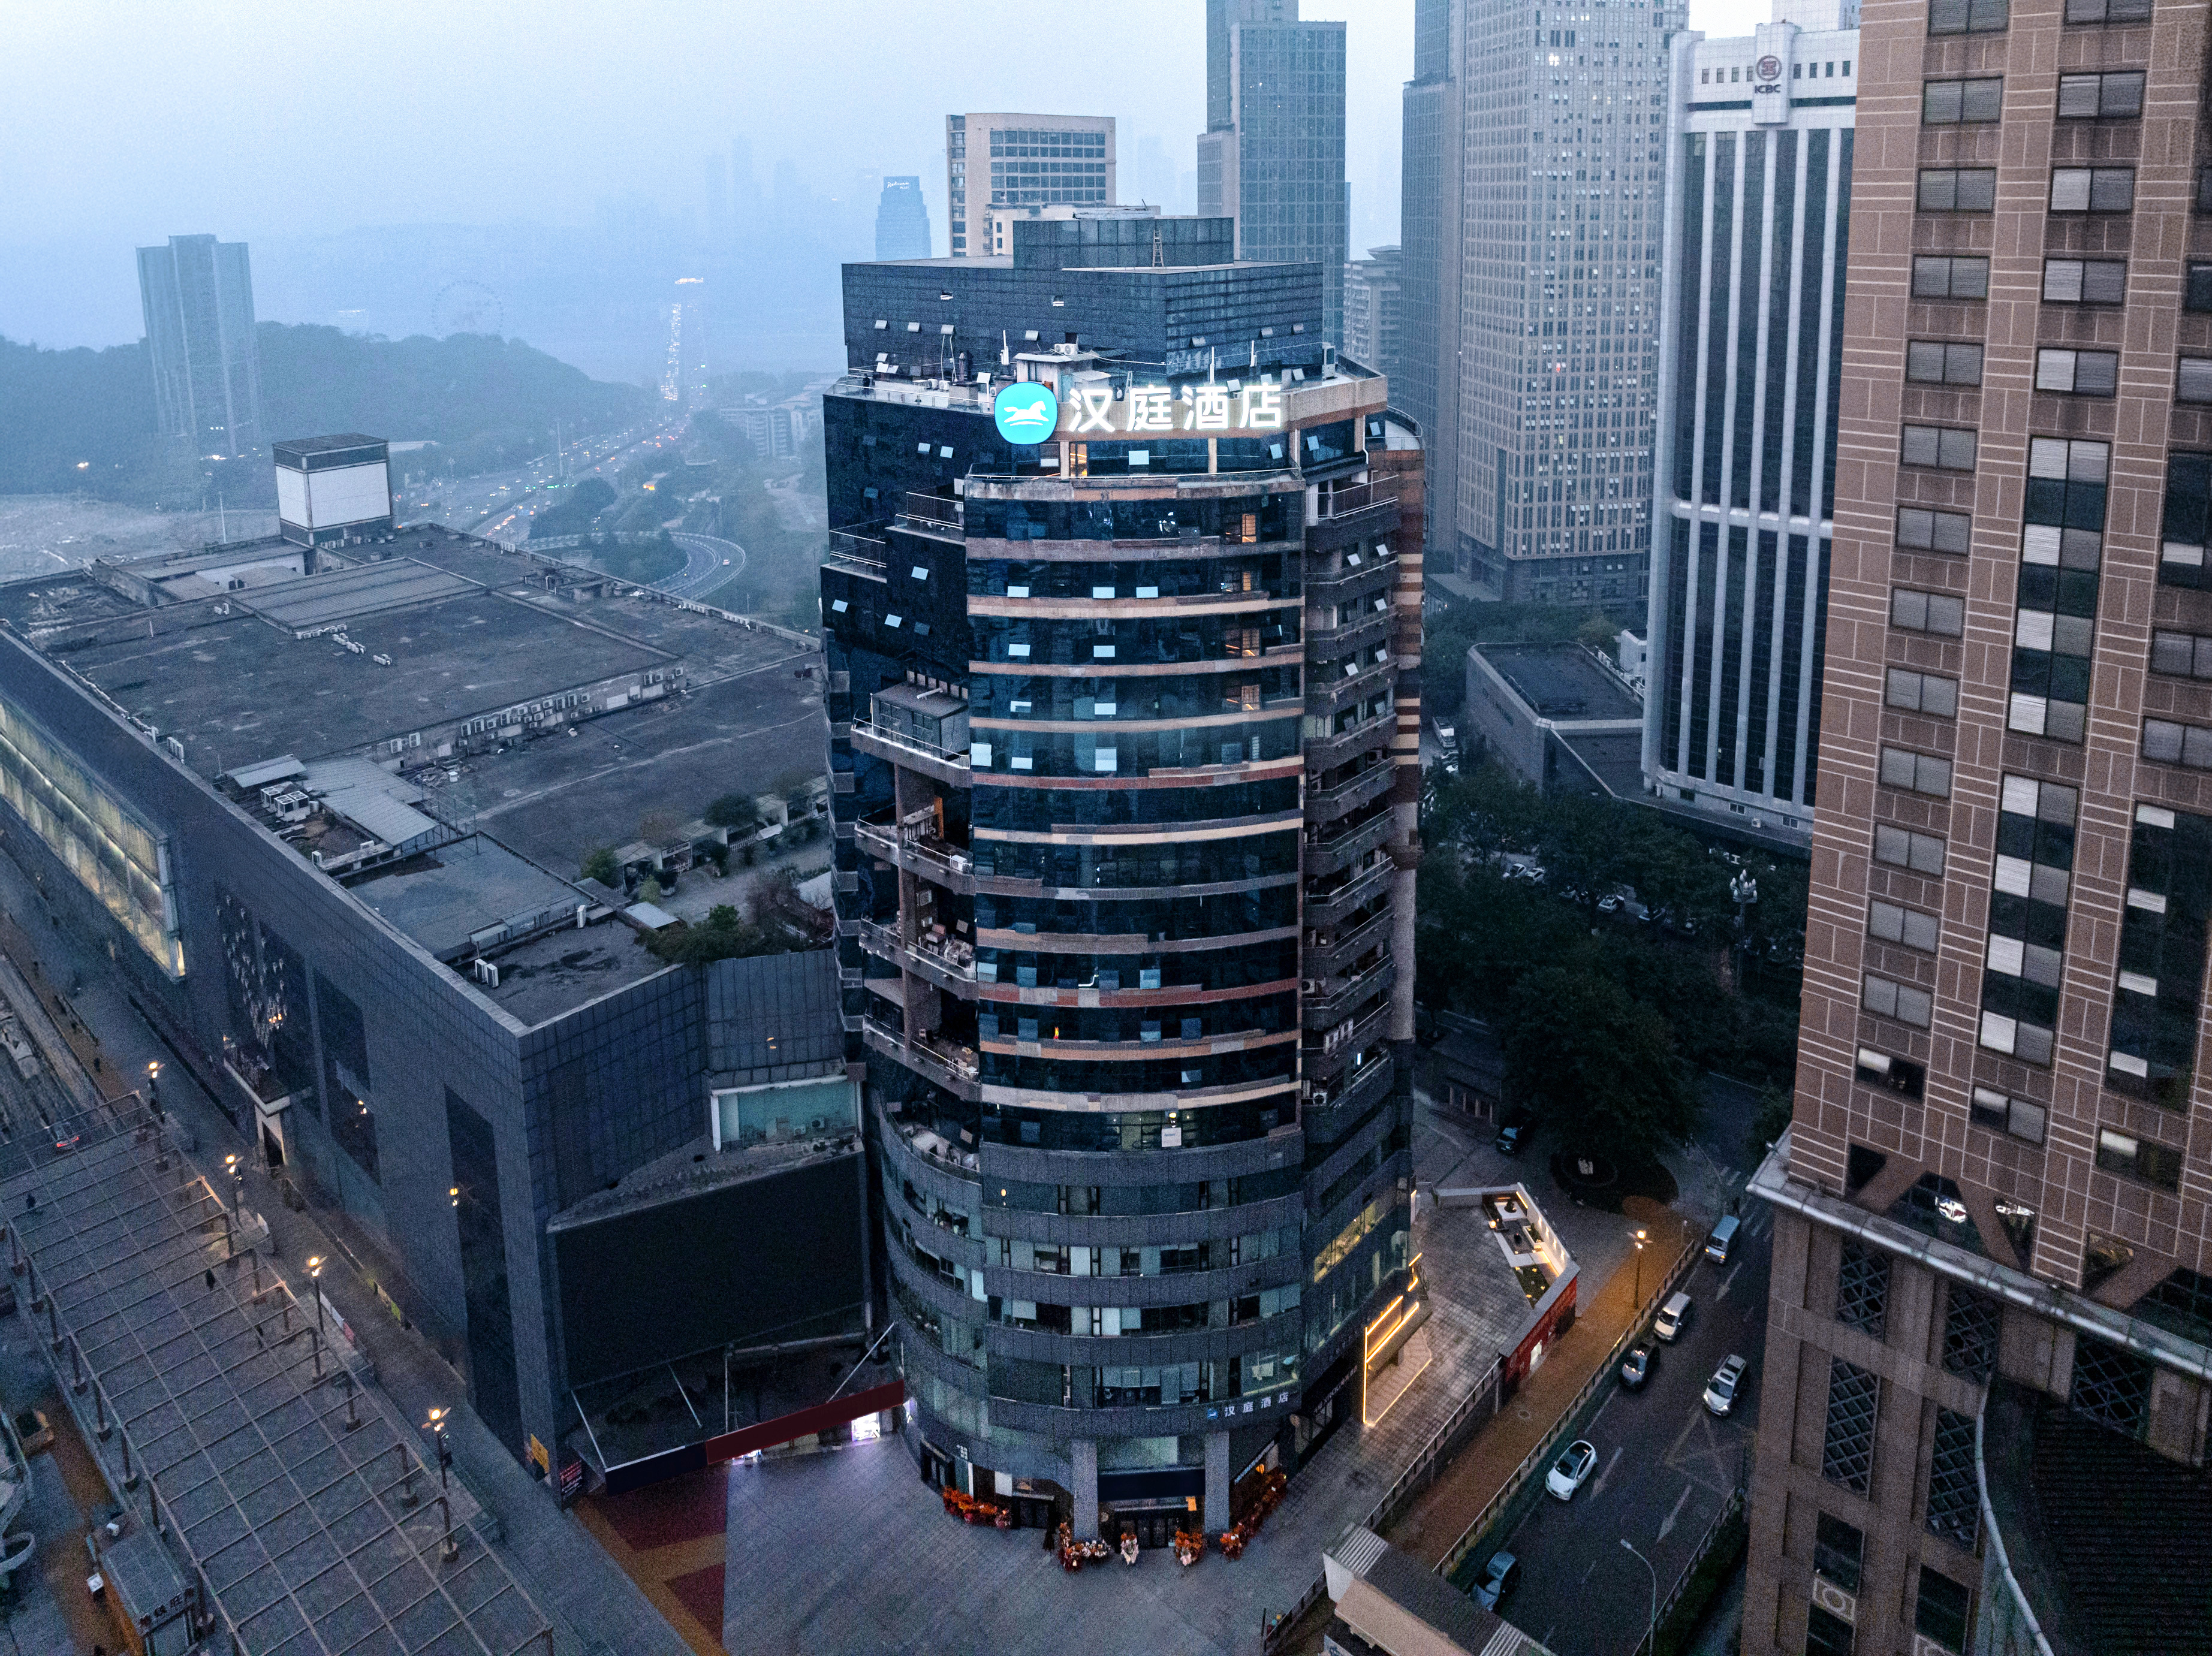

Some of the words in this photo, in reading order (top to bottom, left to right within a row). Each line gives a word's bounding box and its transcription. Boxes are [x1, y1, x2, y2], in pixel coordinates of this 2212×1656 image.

[1754, 84, 1782, 94] ICBC
[1068, 382, 1282, 433] 汉庭酒店
[1225, 1392, 1289, 1417] 汉庭酒店
